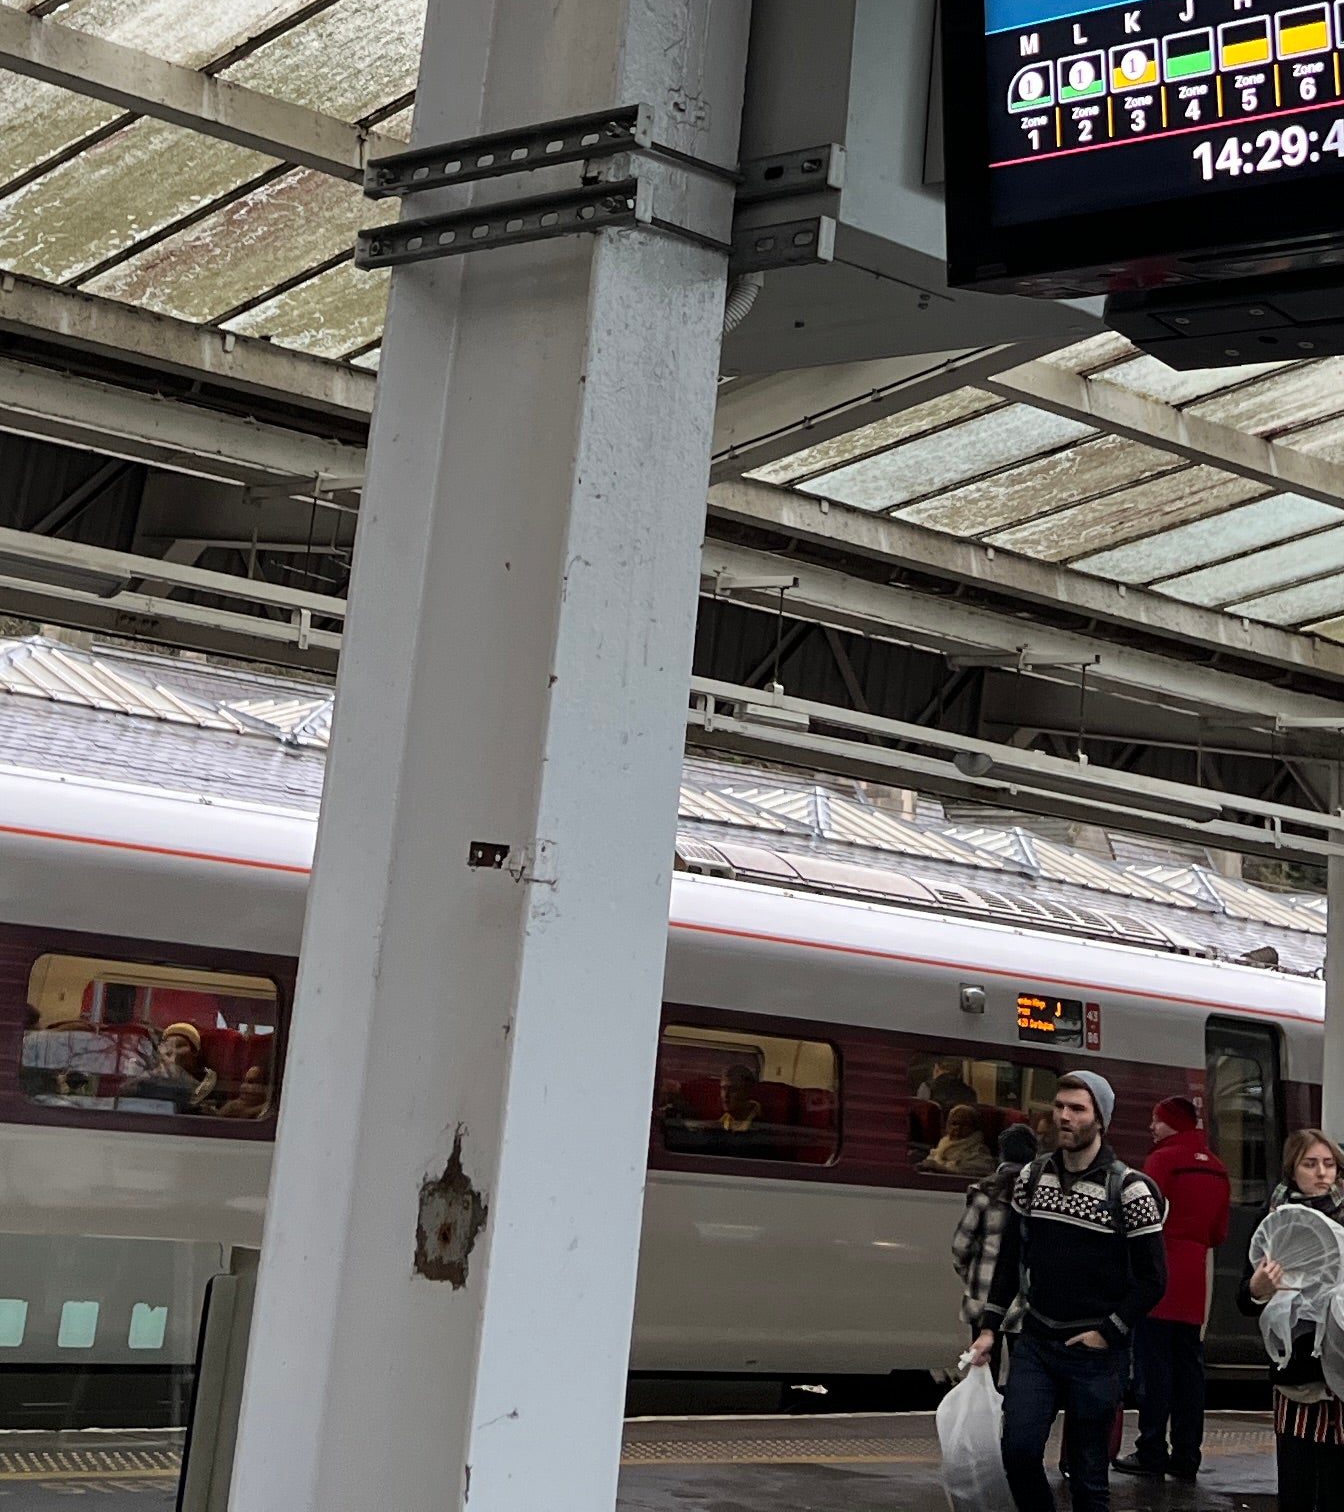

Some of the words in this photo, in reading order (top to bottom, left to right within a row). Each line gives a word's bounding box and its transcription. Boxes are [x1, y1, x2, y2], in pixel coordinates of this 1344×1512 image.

[1020, 33, 1040, 56] M
[1073, 24, 1088, 44] L
[1124, 10, 1141, 33] K
